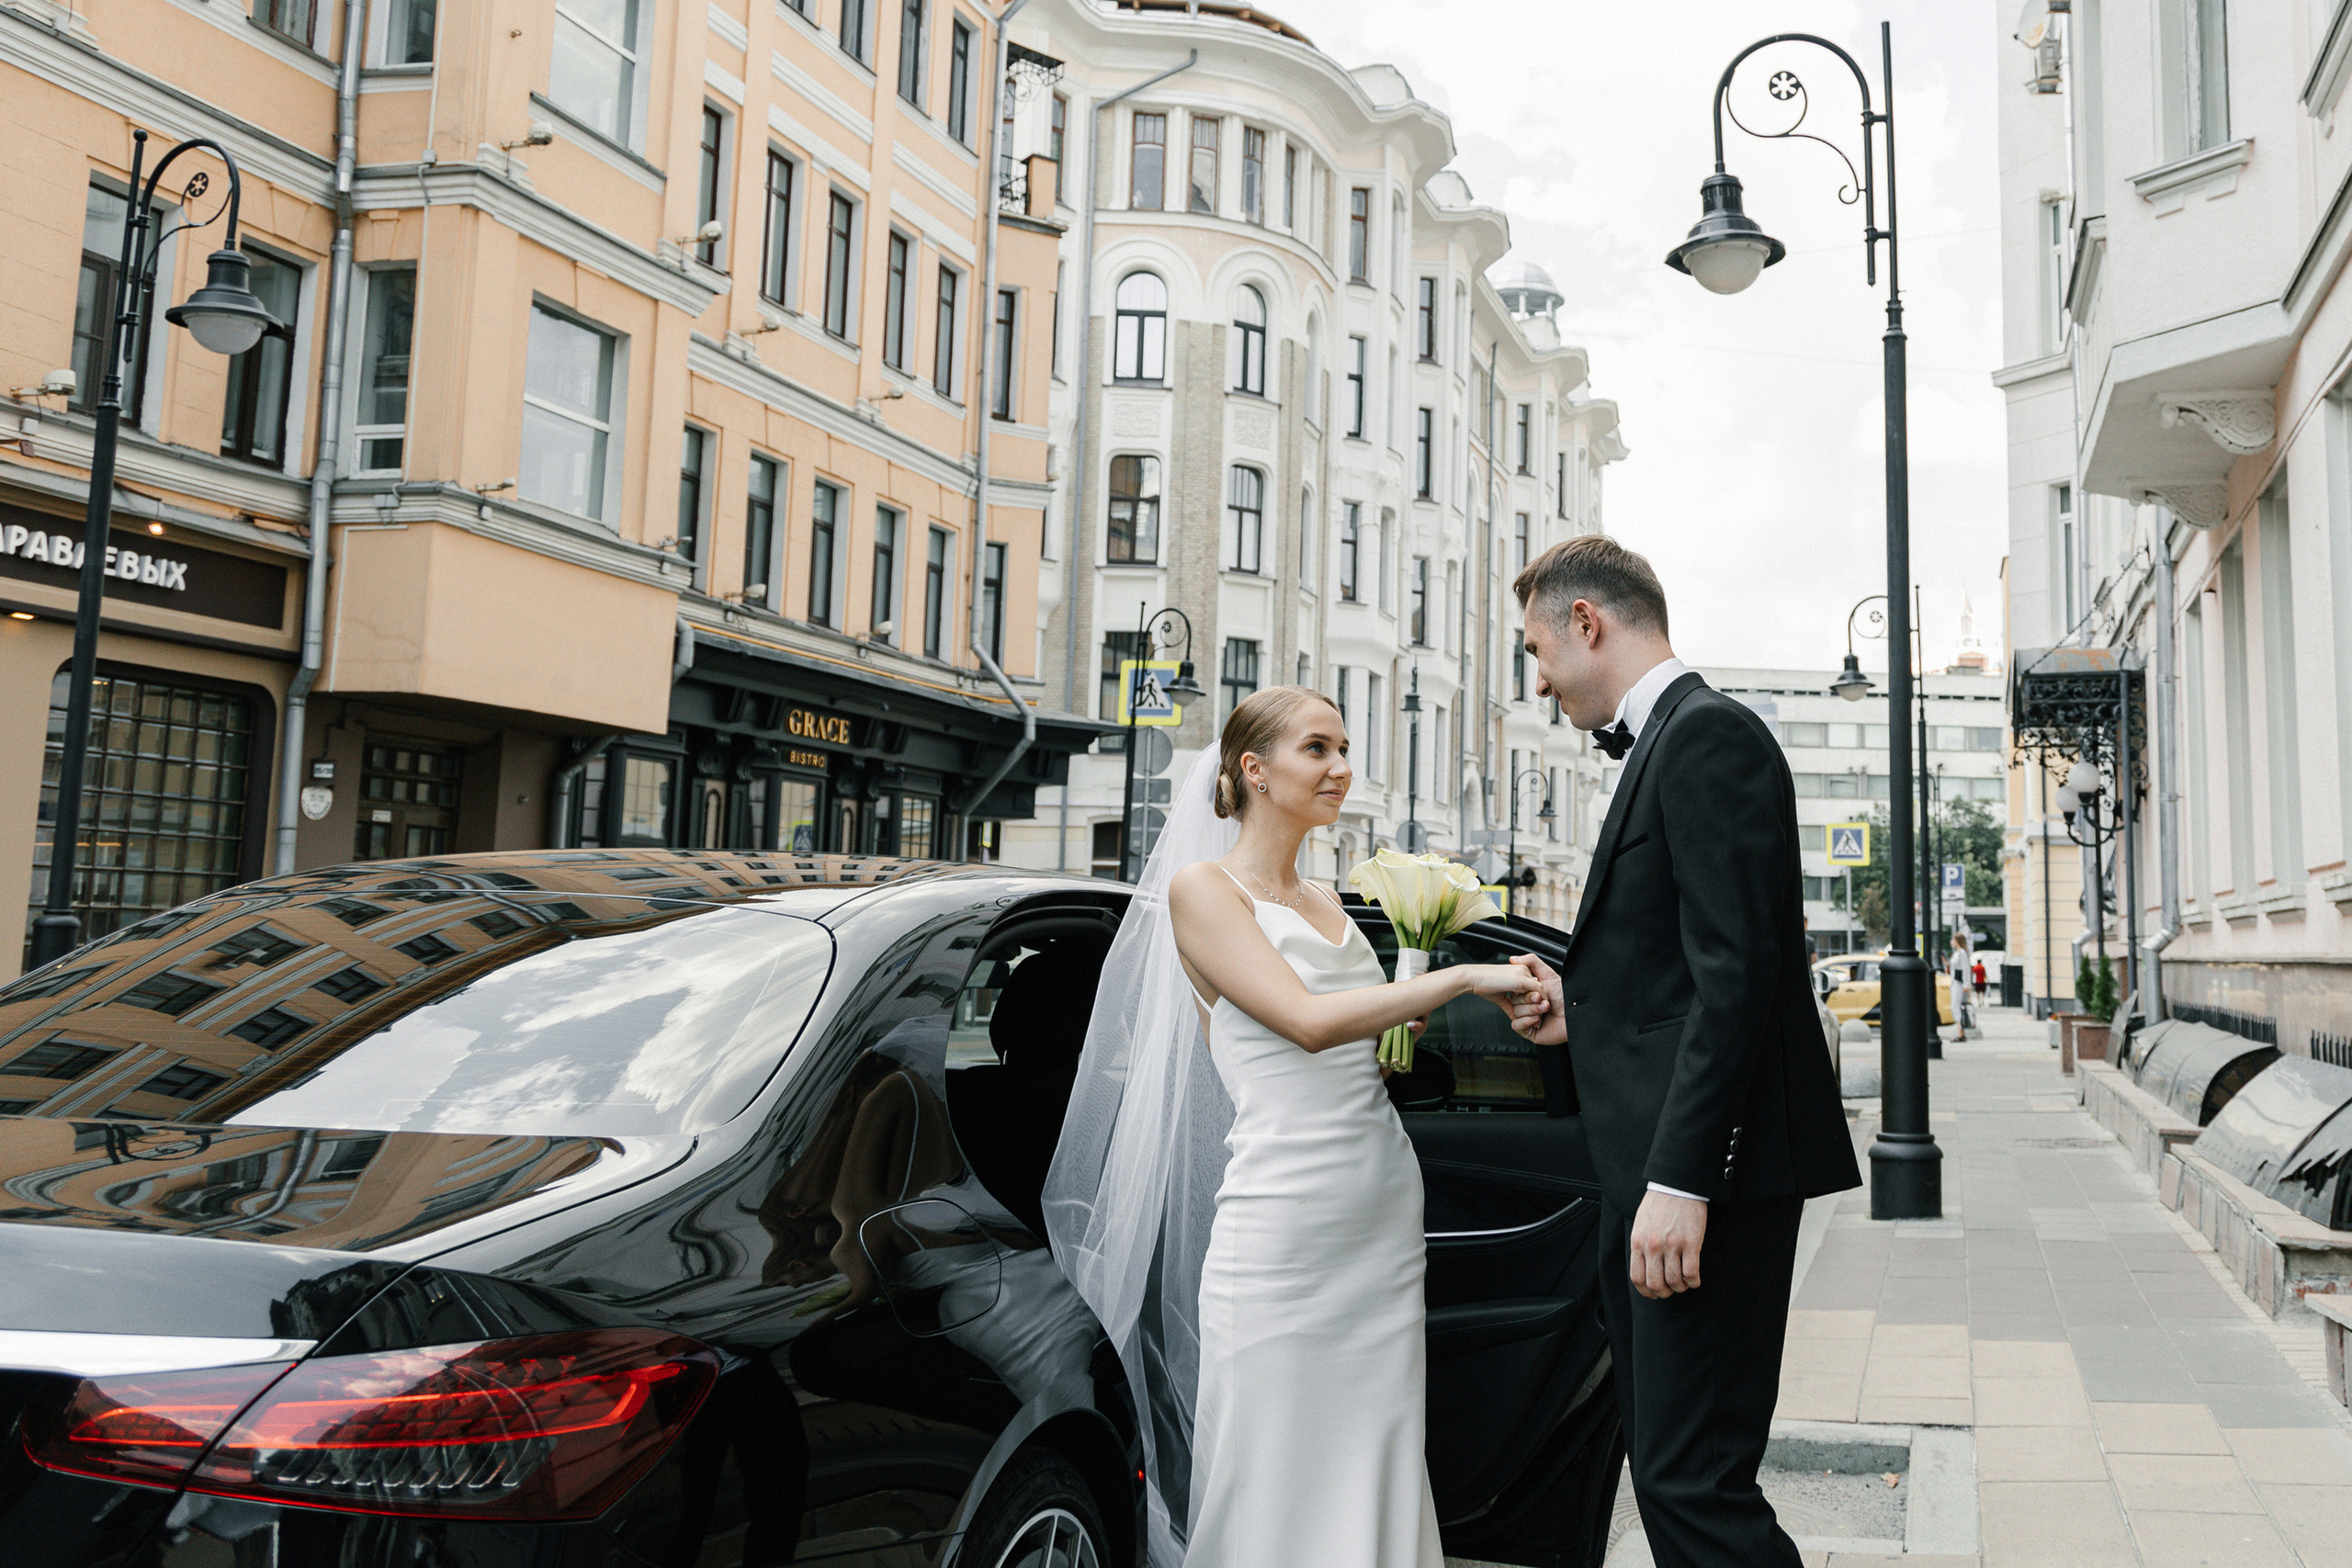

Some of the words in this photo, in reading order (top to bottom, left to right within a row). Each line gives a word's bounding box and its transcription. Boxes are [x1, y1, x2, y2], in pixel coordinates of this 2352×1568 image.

[789, 709, 851, 744] GRACE
[790, 750, 826, 768] BISTRO
[1945, 866, 1960, 886] P
